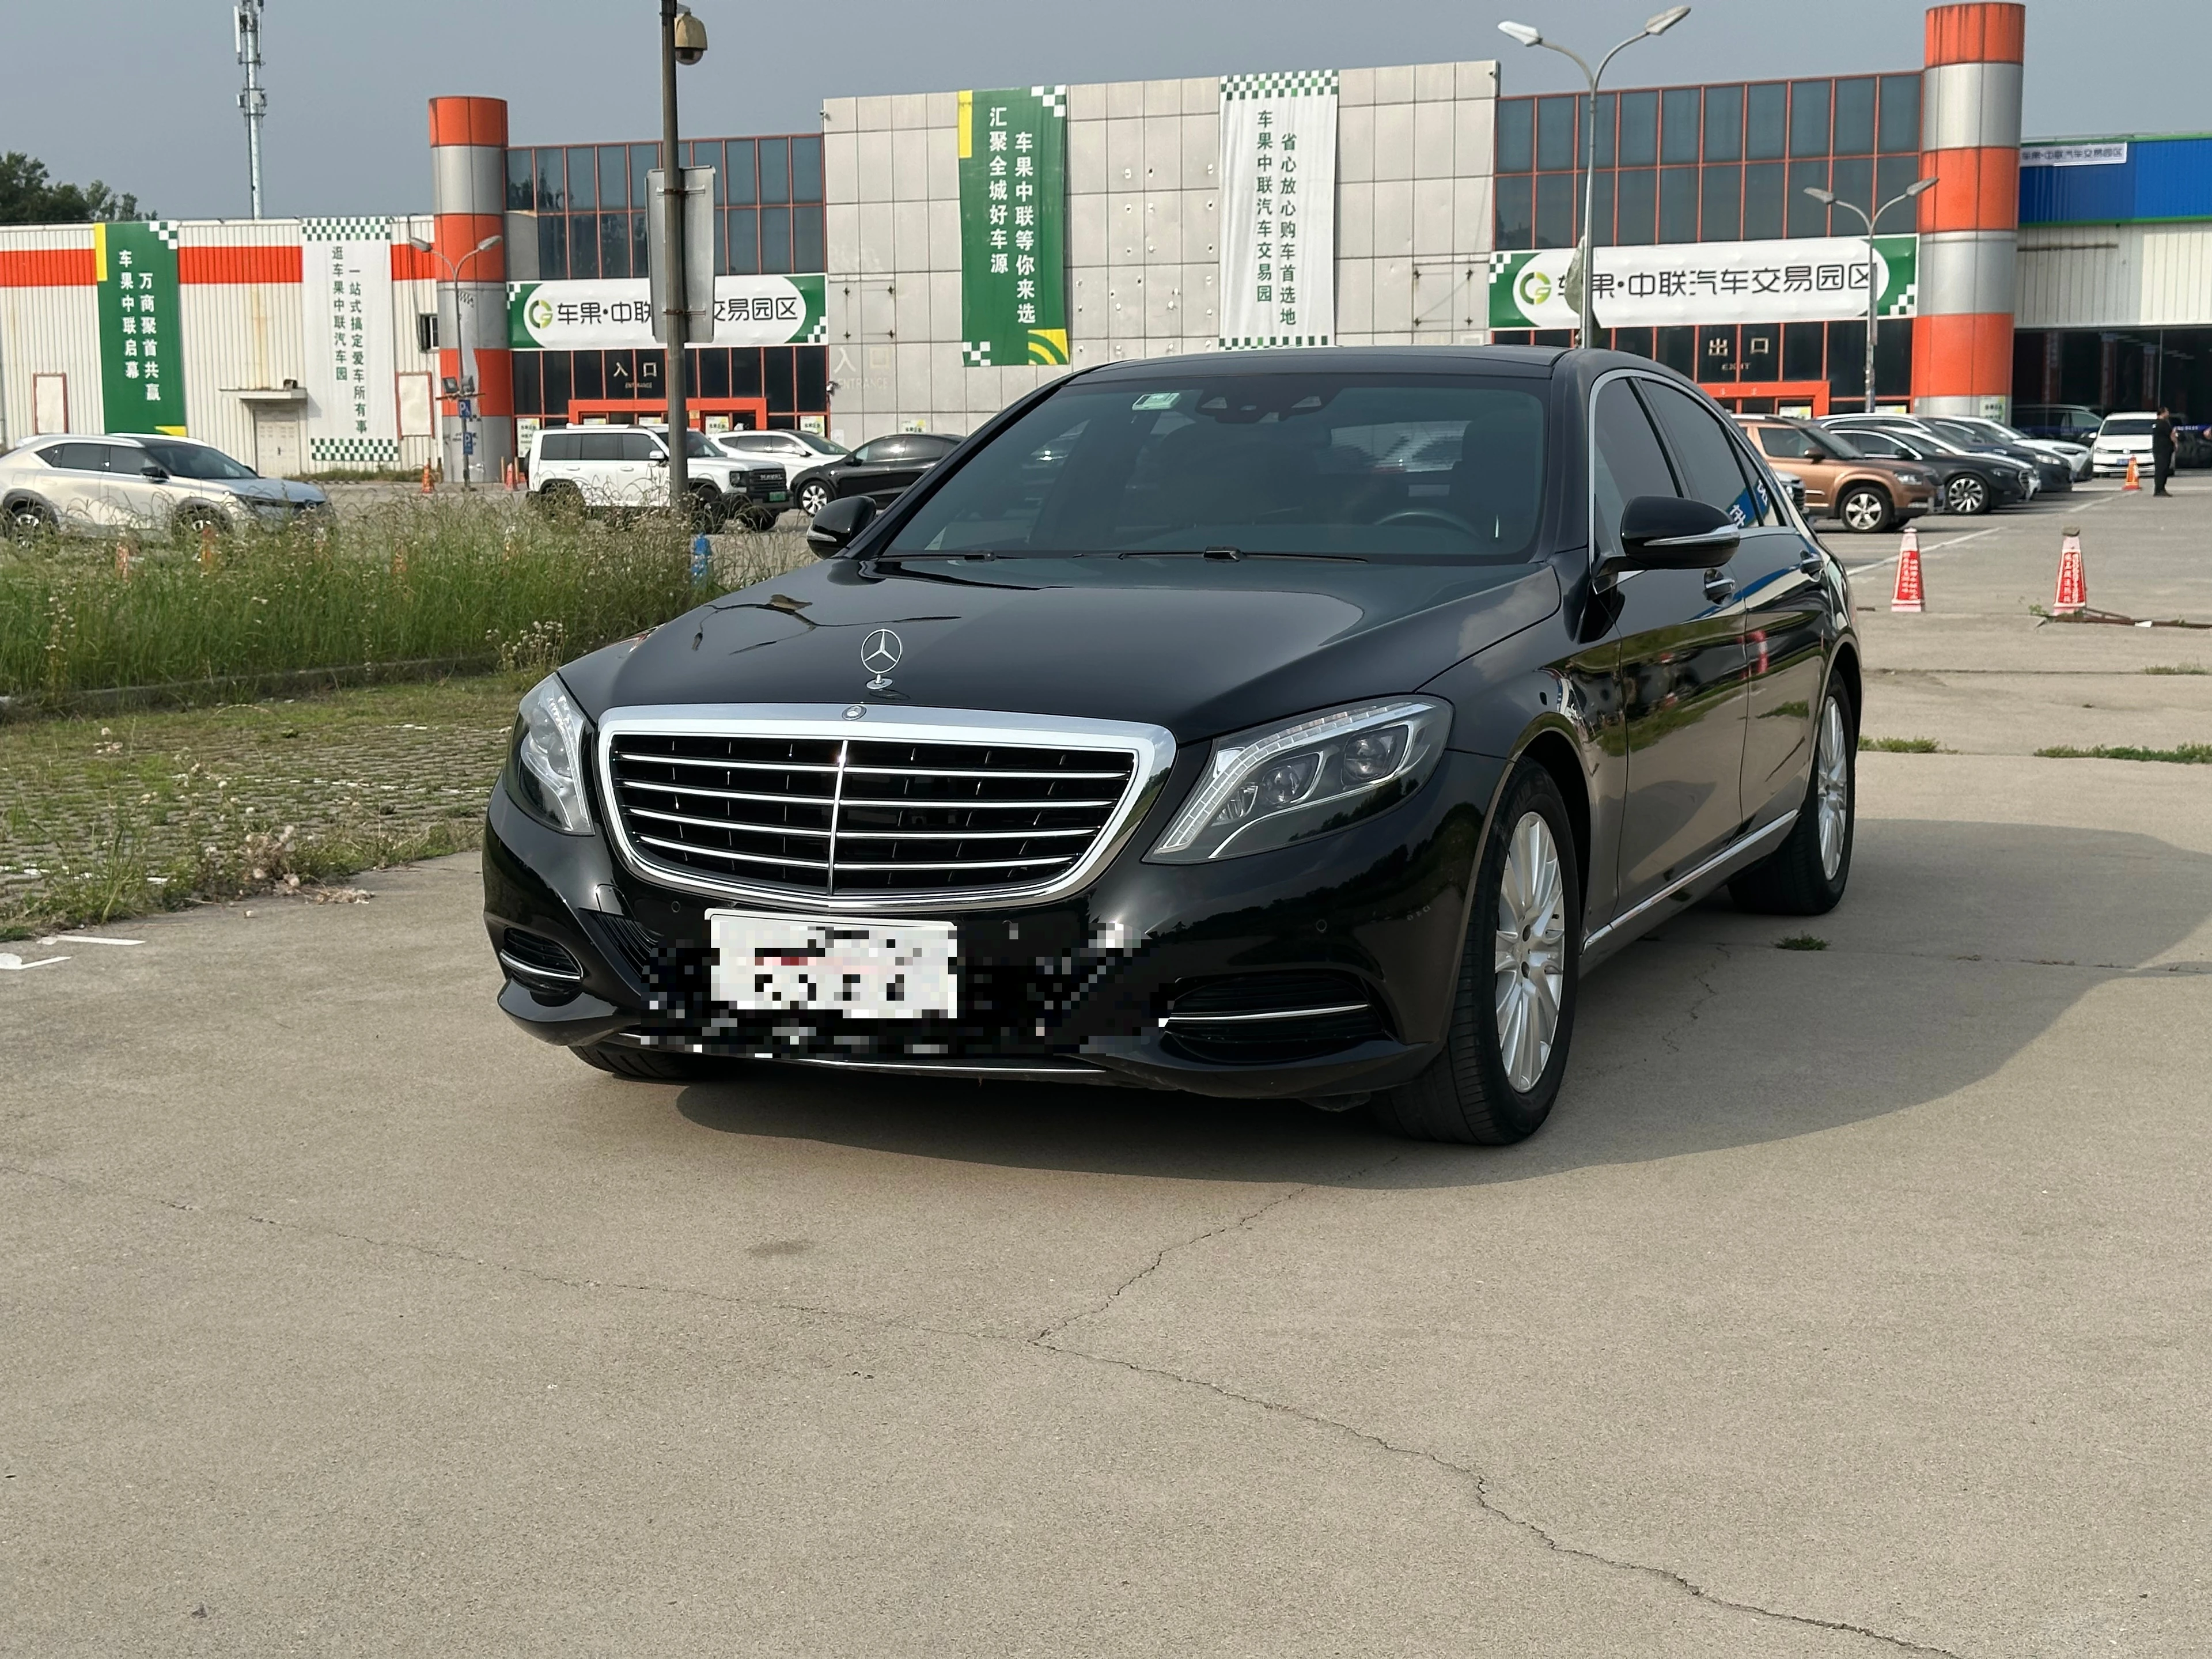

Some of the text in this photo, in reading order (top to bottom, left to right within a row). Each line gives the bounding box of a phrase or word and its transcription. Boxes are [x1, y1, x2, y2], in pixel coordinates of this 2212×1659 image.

[989, 107, 1009, 274] 汇聚全城好车源
[1014, 131, 1036, 324] 车果中联等你来选
[1256, 110, 1273, 302] 车果中联汽车交易园
[1279, 132, 1297, 325] 省心放心购车首选地
[119, 249, 139, 379] 车果中联启幕
[138, 272, 161, 401] 万商聚首共赢
[331, 245, 348, 381] 逛车果中联汽车园
[349, 269, 368, 434] 一站式搞定爱车所有事
[557, 297, 798, 325] 车果·中联交易园区
[613, 361, 657, 377] 入口
[1708, 338, 1770, 356] 出口
